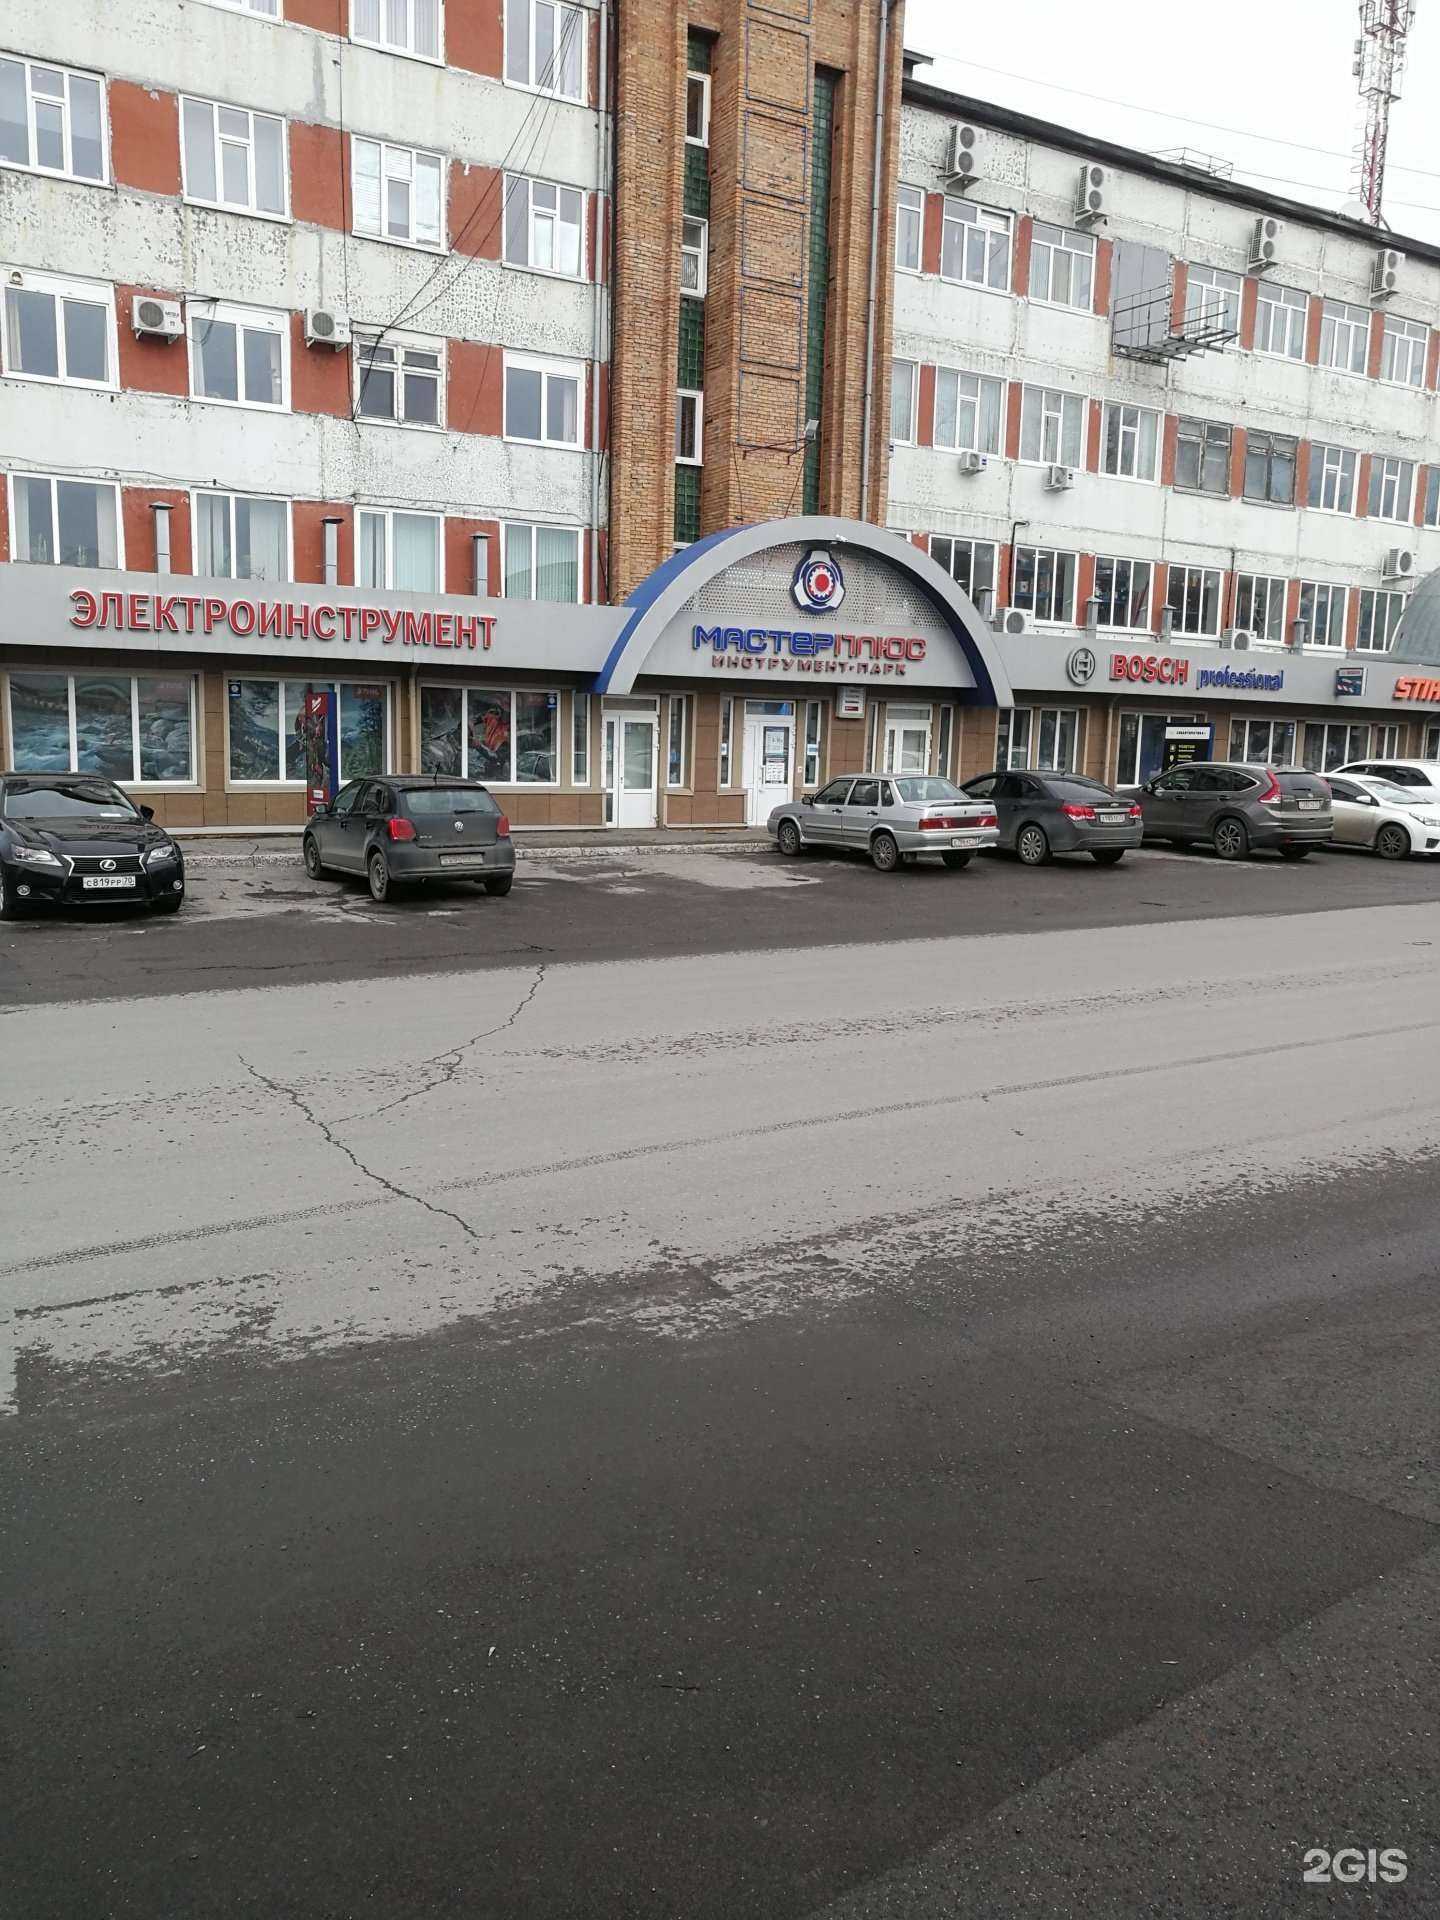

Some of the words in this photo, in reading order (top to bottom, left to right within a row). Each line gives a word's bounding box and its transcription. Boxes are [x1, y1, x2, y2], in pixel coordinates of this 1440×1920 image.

[70, 588, 497, 648] ЭЛЕКТРОИНСТРУМЕНТ
[1110, 654, 1188, 684] BOSCH
[1199, 665, 1284, 691] professional
